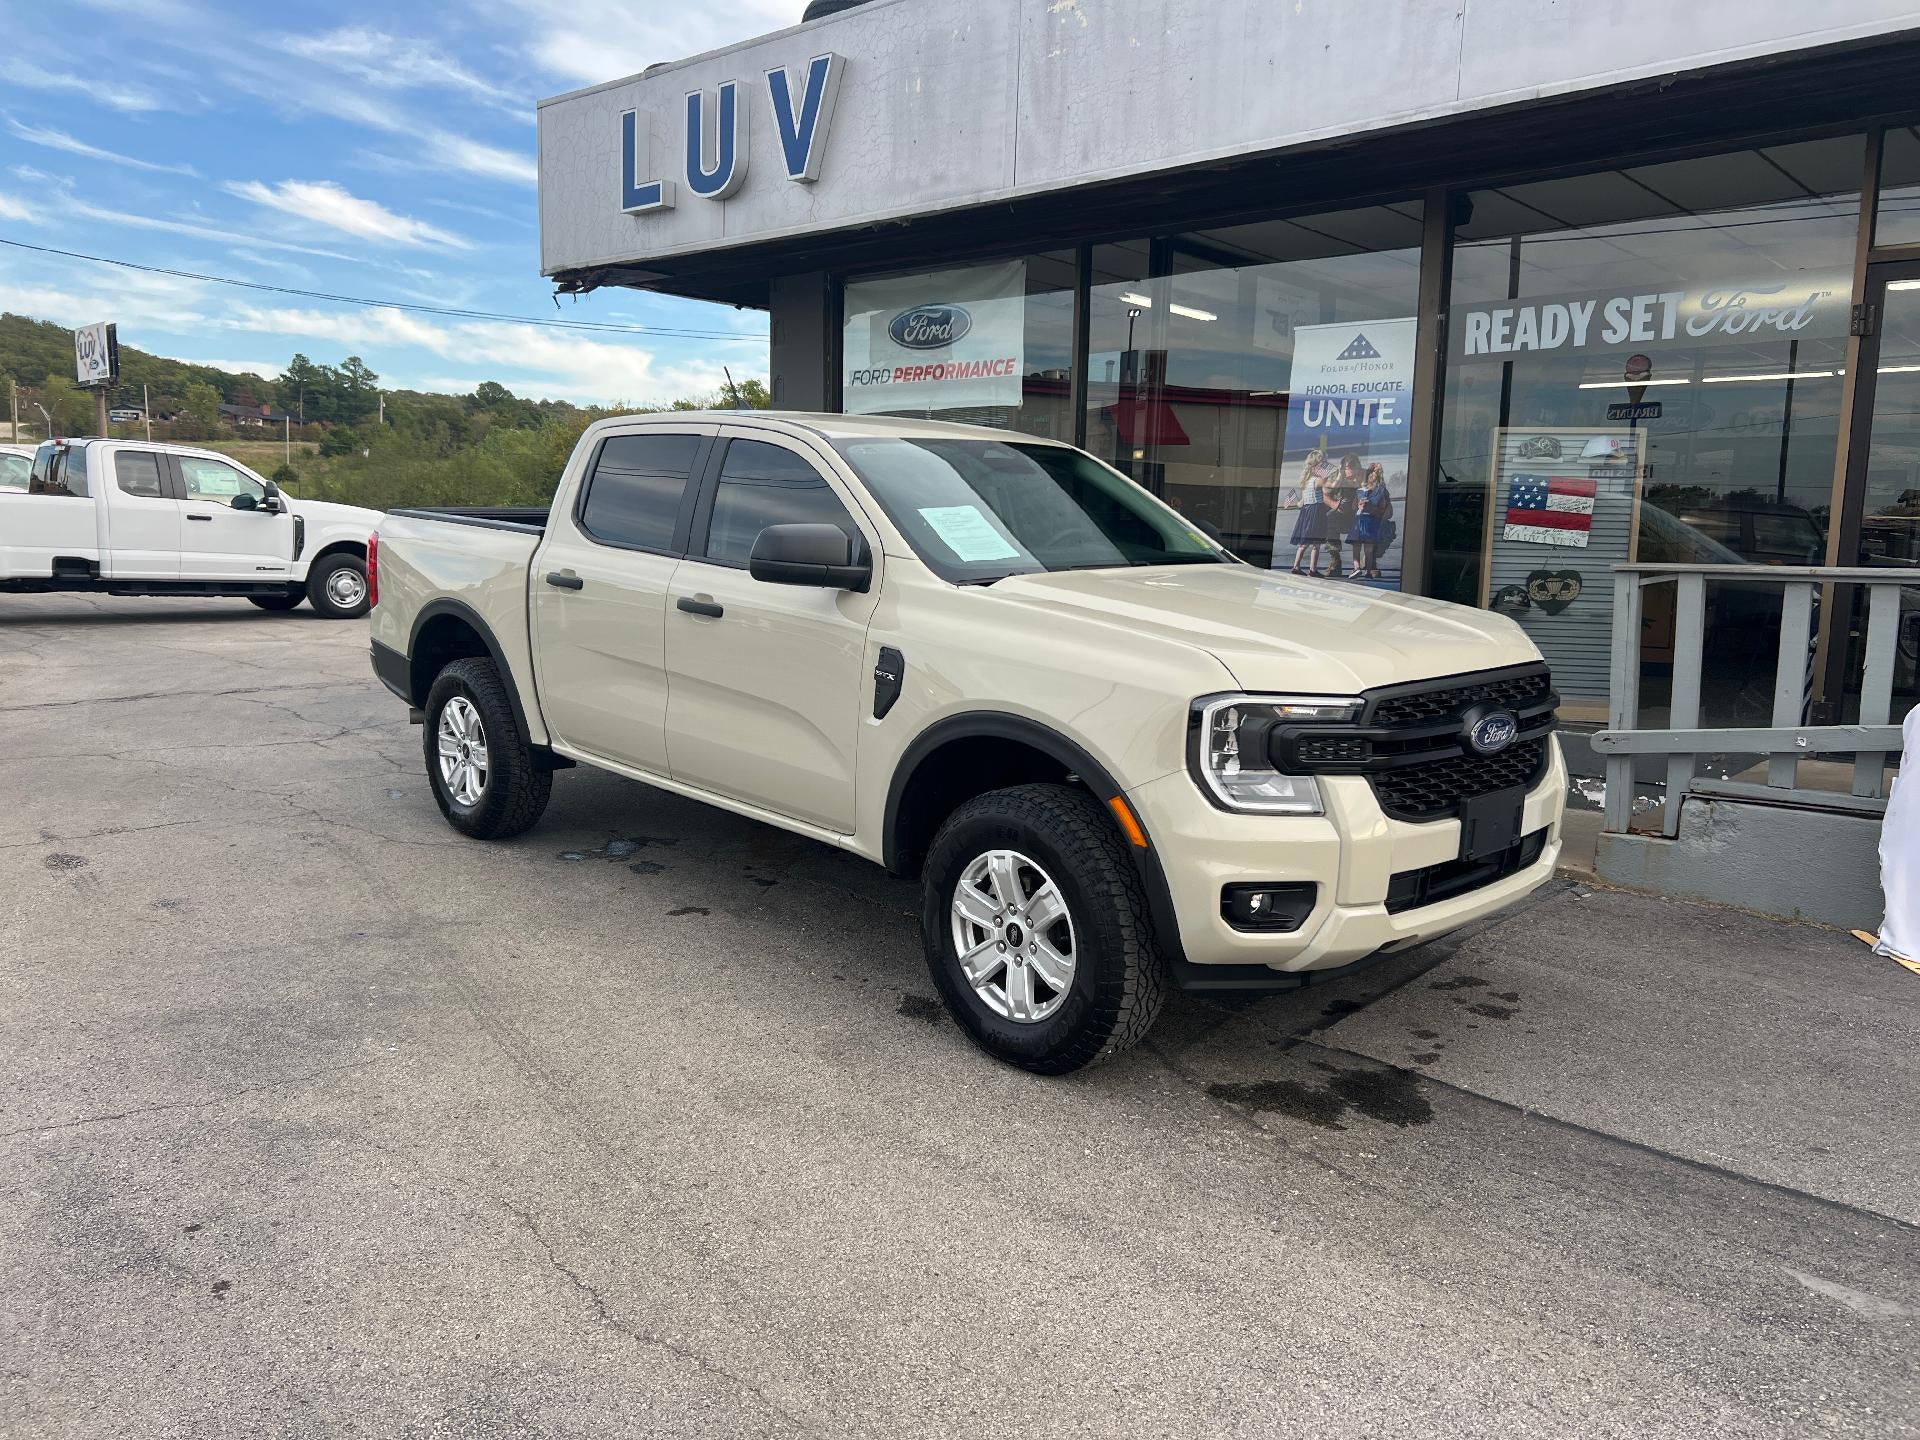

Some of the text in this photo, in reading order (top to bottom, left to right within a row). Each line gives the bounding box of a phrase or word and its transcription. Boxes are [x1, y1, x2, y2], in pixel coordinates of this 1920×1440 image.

[620, 52, 846, 216] LUV
[903, 311, 955, 341] Ford
[1463, 300, 1597, 356] READY
[1601, 291, 1686, 345] SET
[1685, 283, 1820, 337] Ford
[851, 357, 1017, 386] FORD PERFORMANCE
[1305, 381, 1405, 396] HONOR. EDUCATE.
[1303, 398, 1402, 427] UNITE.
[1484, 721, 1509, 744] Ford
